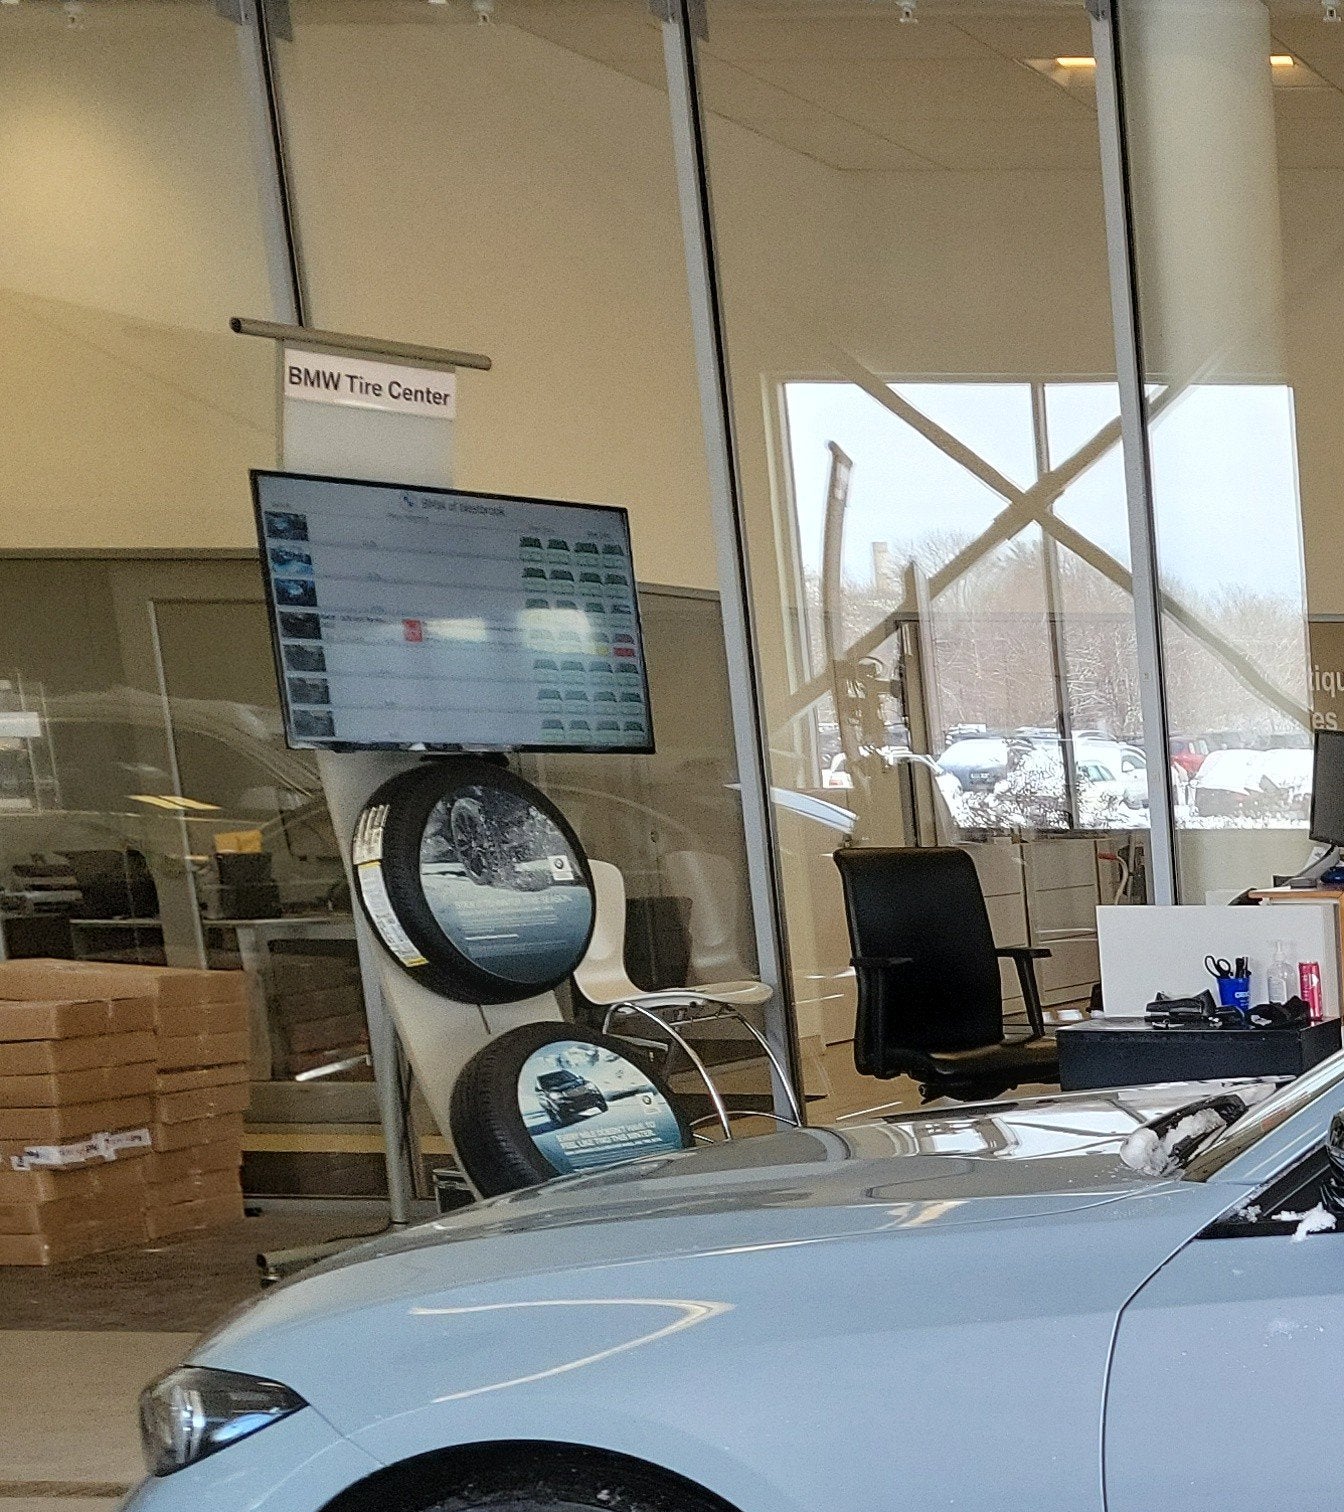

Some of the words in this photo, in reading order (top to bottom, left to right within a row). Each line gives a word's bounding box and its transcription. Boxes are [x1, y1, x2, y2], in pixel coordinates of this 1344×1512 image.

[288, 365, 341, 391] BMW
[345, 374, 382, 397] Tire
[388, 380, 450, 406] Center
